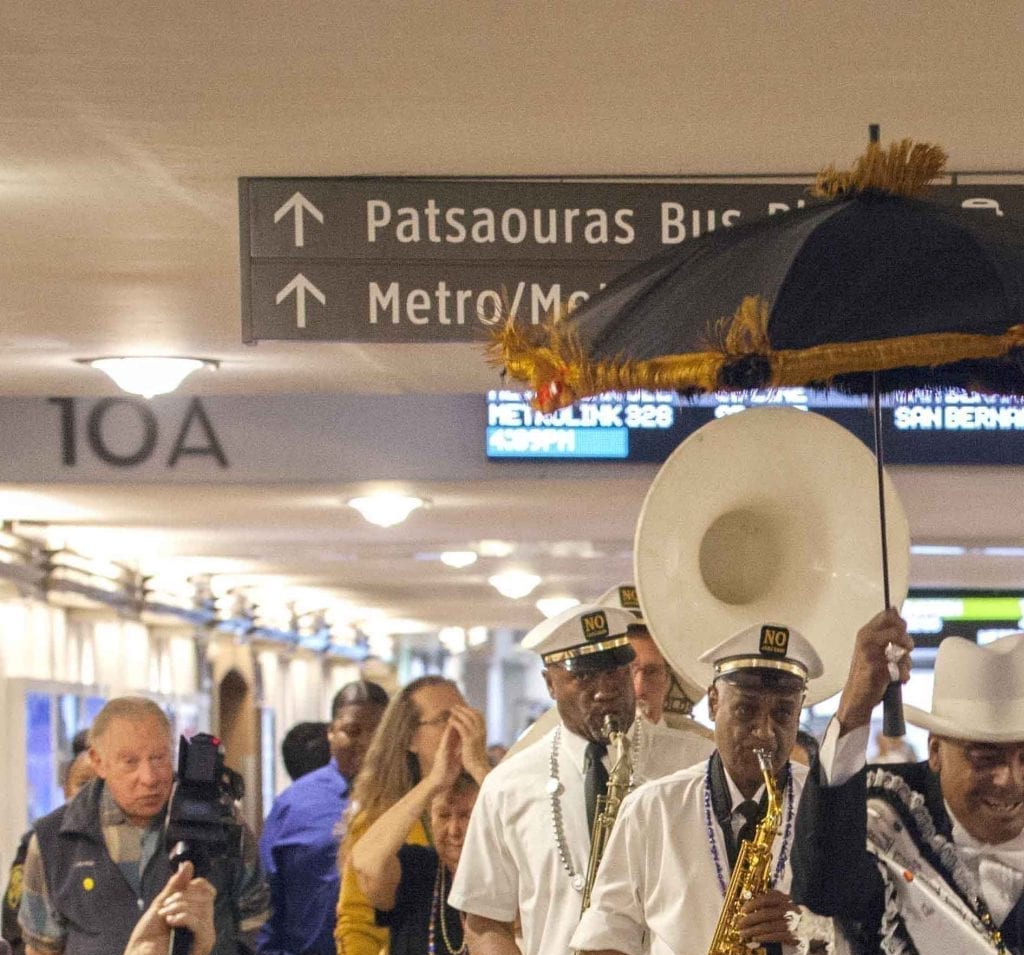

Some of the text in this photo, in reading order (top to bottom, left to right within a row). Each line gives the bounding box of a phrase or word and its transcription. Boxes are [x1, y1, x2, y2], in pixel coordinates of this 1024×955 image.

[367, 200, 636, 246] Patsaouras
[895, 406, 943, 430] SAN
[47, 396, 230, 469] 10A
[583, 614, 605, 631] NO
[764, 629, 787, 647] NO
